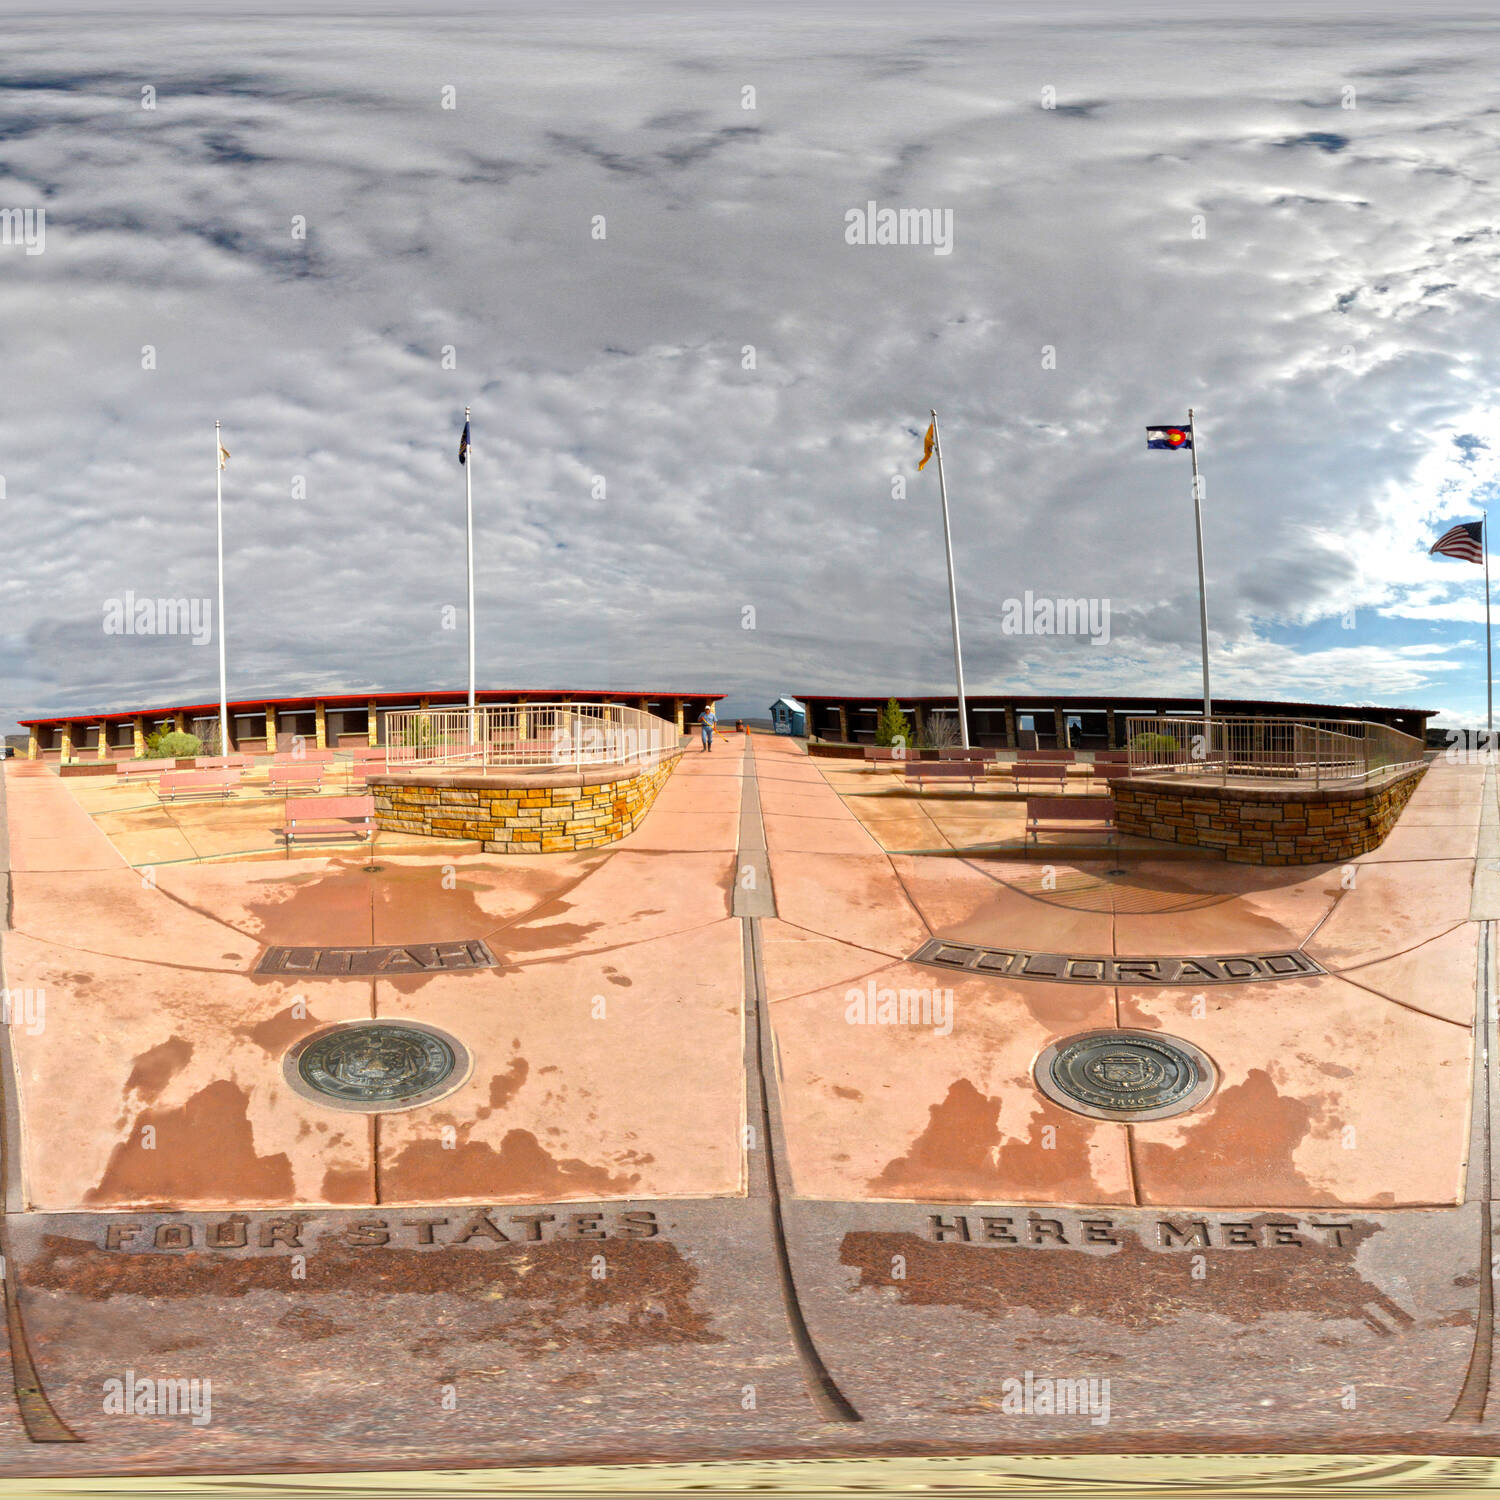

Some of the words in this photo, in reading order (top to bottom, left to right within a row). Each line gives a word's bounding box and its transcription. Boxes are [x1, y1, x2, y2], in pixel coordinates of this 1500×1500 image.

[278, 944, 481, 972] UTAH
[933, 944, 1310, 980] COLORADO
[105, 1214, 304, 1250] FOUR
[345, 1209, 659, 1246] STATES
[927, 1215, 1118, 1245] HERE
[1157, 1220, 1353, 1248] MEET
